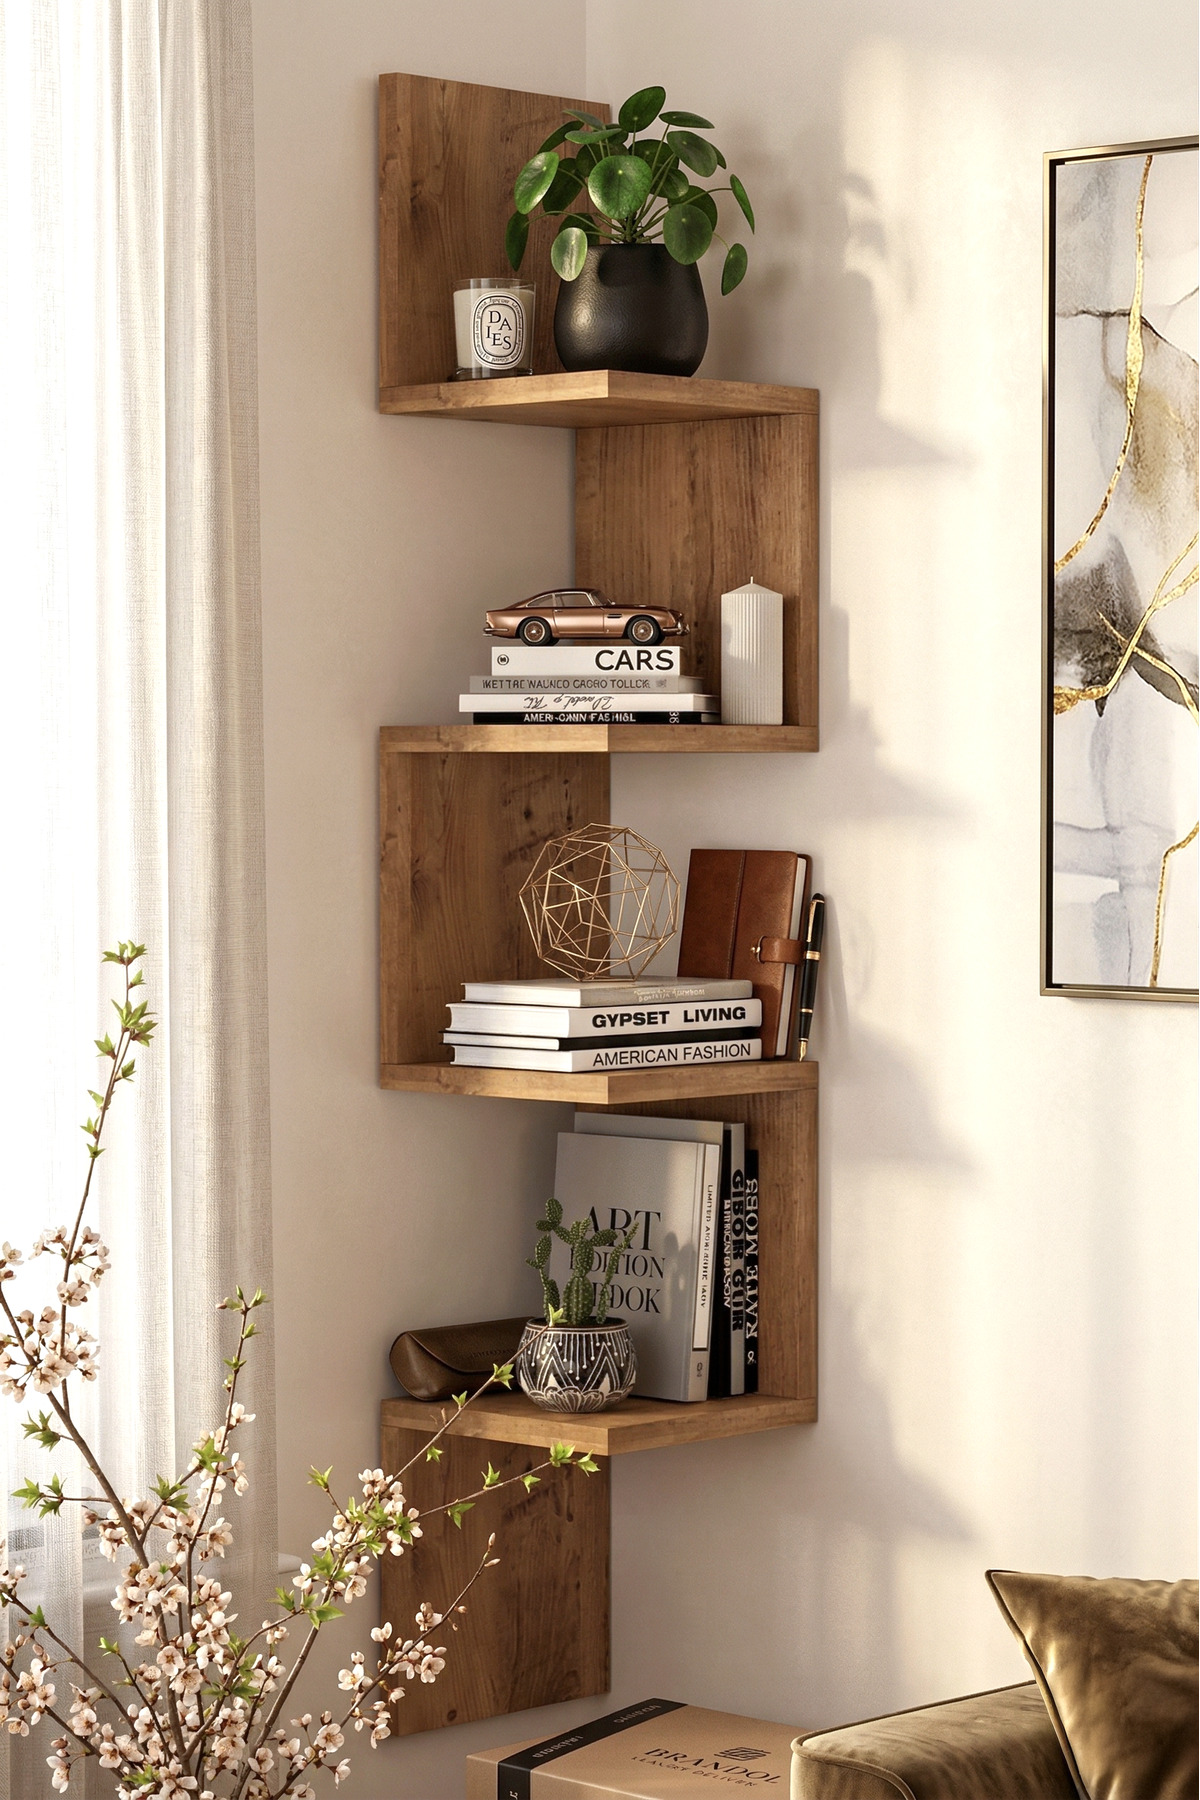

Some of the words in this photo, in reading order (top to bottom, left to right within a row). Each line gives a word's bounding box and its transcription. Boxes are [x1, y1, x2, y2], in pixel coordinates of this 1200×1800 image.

[595, 649, 674, 671] CARS
[592, 1011, 670, 1028] GYPSET
[683, 1006, 746, 1023] LIVING
[593, 1048, 678, 1067] AMERICAN
[683, 1043, 751, 1060] FASHION
[644, 1748, 781, 1784] BRANDOL
